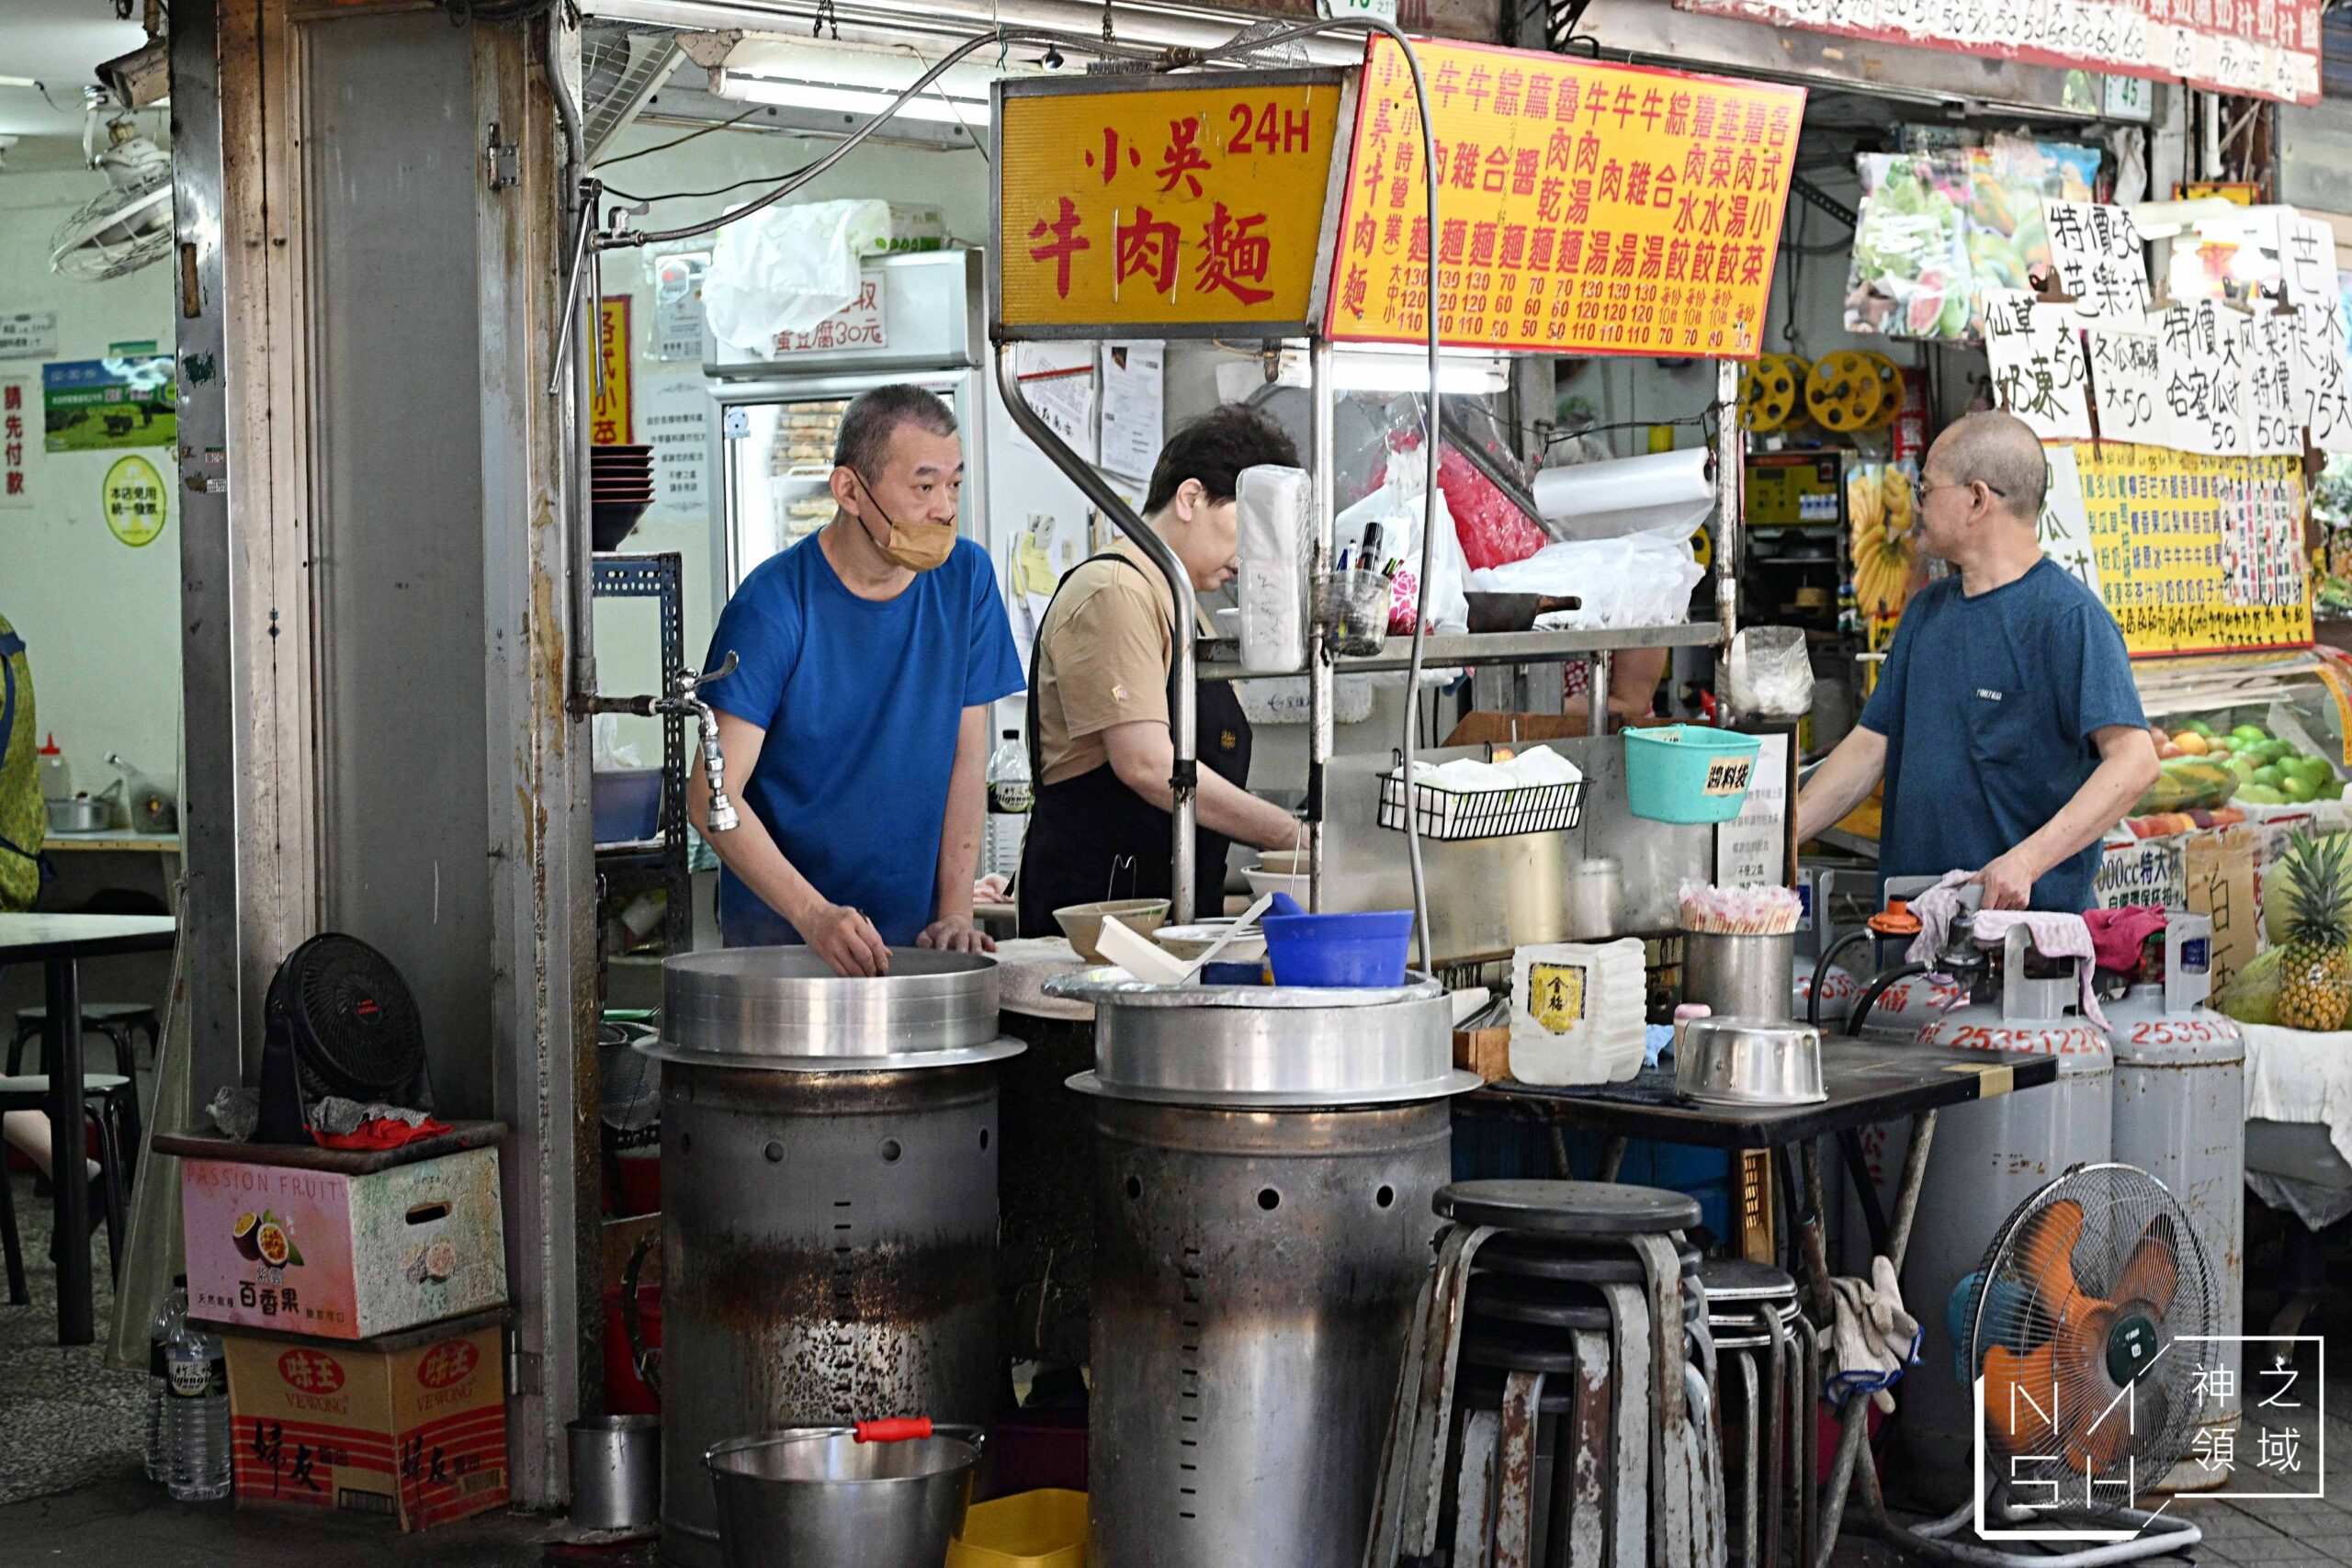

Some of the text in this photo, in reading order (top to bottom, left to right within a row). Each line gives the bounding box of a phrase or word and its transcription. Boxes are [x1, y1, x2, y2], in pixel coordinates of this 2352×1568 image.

[1227, 102, 1310, 154] 24H
[1086, 118, 1213, 198] 小吳
[1341, 50, 1401, 317] 小吳牛肉麵
[1439, 64, 1491, 265] 牛雜麵
[1469, 68, 1524, 267] 綜合麵
[1556, 80, 1609, 274] 牛肉湯麵
[1584, 84, 1636, 276] 牛肉湯
[1611, 87, 1664, 277] 牛雜湯
[1638, 91, 1691, 279] 綜合湯
[1740, 105, 1791, 286] 各式小菜
[1028, 196, 1274, 305] 牛肉麵
[2050, 204, 2114, 255] 特價
[1387, 285, 1399, 303] 中
[1401, 291, 1427, 309] 120
[1438, 294, 1456, 311] 20
[1462, 295, 1487, 313] 120
[1495, 296, 1512, 313] 60
[1524, 299, 1542, 316] 60
[1552, 300, 1569, 318] 60
[1577, 302, 1600, 321] 120
[1603, 304, 1627, 321] 120
[1631, 305, 1654, 323] 120
[1389, 264, 1402, 283] 大
[1466, 272, 1490, 290] 130
[1500, 274, 1516, 291] 70
[1530, 276, 1544, 295] 70
[1557, 279, 1573, 296] 70
[1580, 281, 1603, 299] 130
[1608, 283, 1630, 300] 130
[1635, 284, 1657, 302] 130
[1383, 304, 1396, 324] 小
[1397, 313, 1422, 331] 110
[1439, 315, 1453, 333] 10
[1458, 316, 1483, 334] 110
[1521, 320, 1537, 338] 50
[1547, 321, 1566, 340] 50
[1572, 322, 1595, 340] 110
[1600, 324, 1623, 342] 110
[1627, 325, 1649, 343] 110
[1659, 327, 1673, 344] 70
[1684, 328, 1698, 345] 70
[1708, 331, 1723, 347] 80
[1985, 294, 2037, 350] 仙草
[2054, 345, 2085, 389] 50
[2163, 299, 2242, 367] 特價 大
[2106, 381, 2152, 427] 大 50
[2253, 360, 2292, 412] 特價
[5, 386, 24, 495] 請先付款
[2211, 421, 2235, 450] 50
[2258, 415, 2285, 449] 50
[1707, 762, 1749, 789] 醬料袋
[187, 1167, 268, 1192] PASSION
[239, 1280, 299, 1315] 百香果
[286, 1351, 337, 1388] 味王
[426, 1343, 469, 1384] 味王
[286, 1393, 347, 1415] VEWONG
[417, 1385, 472, 1412] VEWONG
